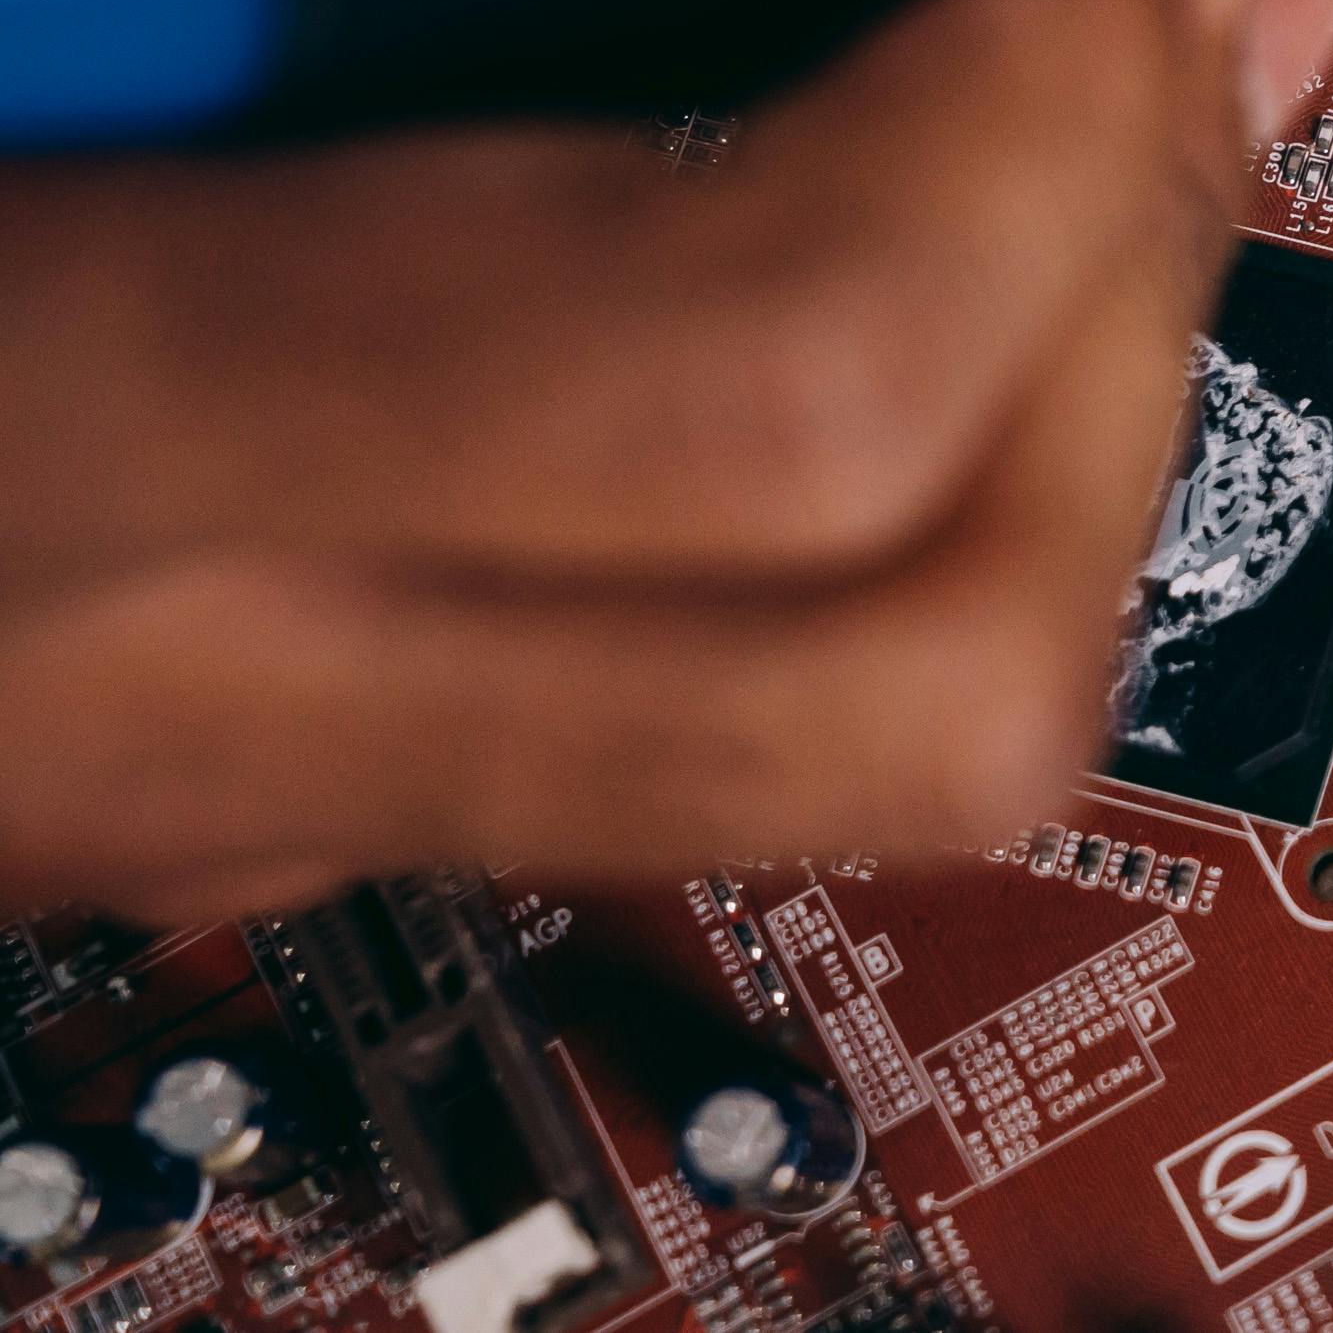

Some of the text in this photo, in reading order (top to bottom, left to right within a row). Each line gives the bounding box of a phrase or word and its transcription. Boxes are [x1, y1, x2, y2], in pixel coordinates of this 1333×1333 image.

[1262, 141, 1286, 183] C300
[1286, 201, 1308, 232] L15
[520, 907, 573, 958] AGP
[862, 945, 890, 976] B
[1133, 998, 1156, 1030] P
